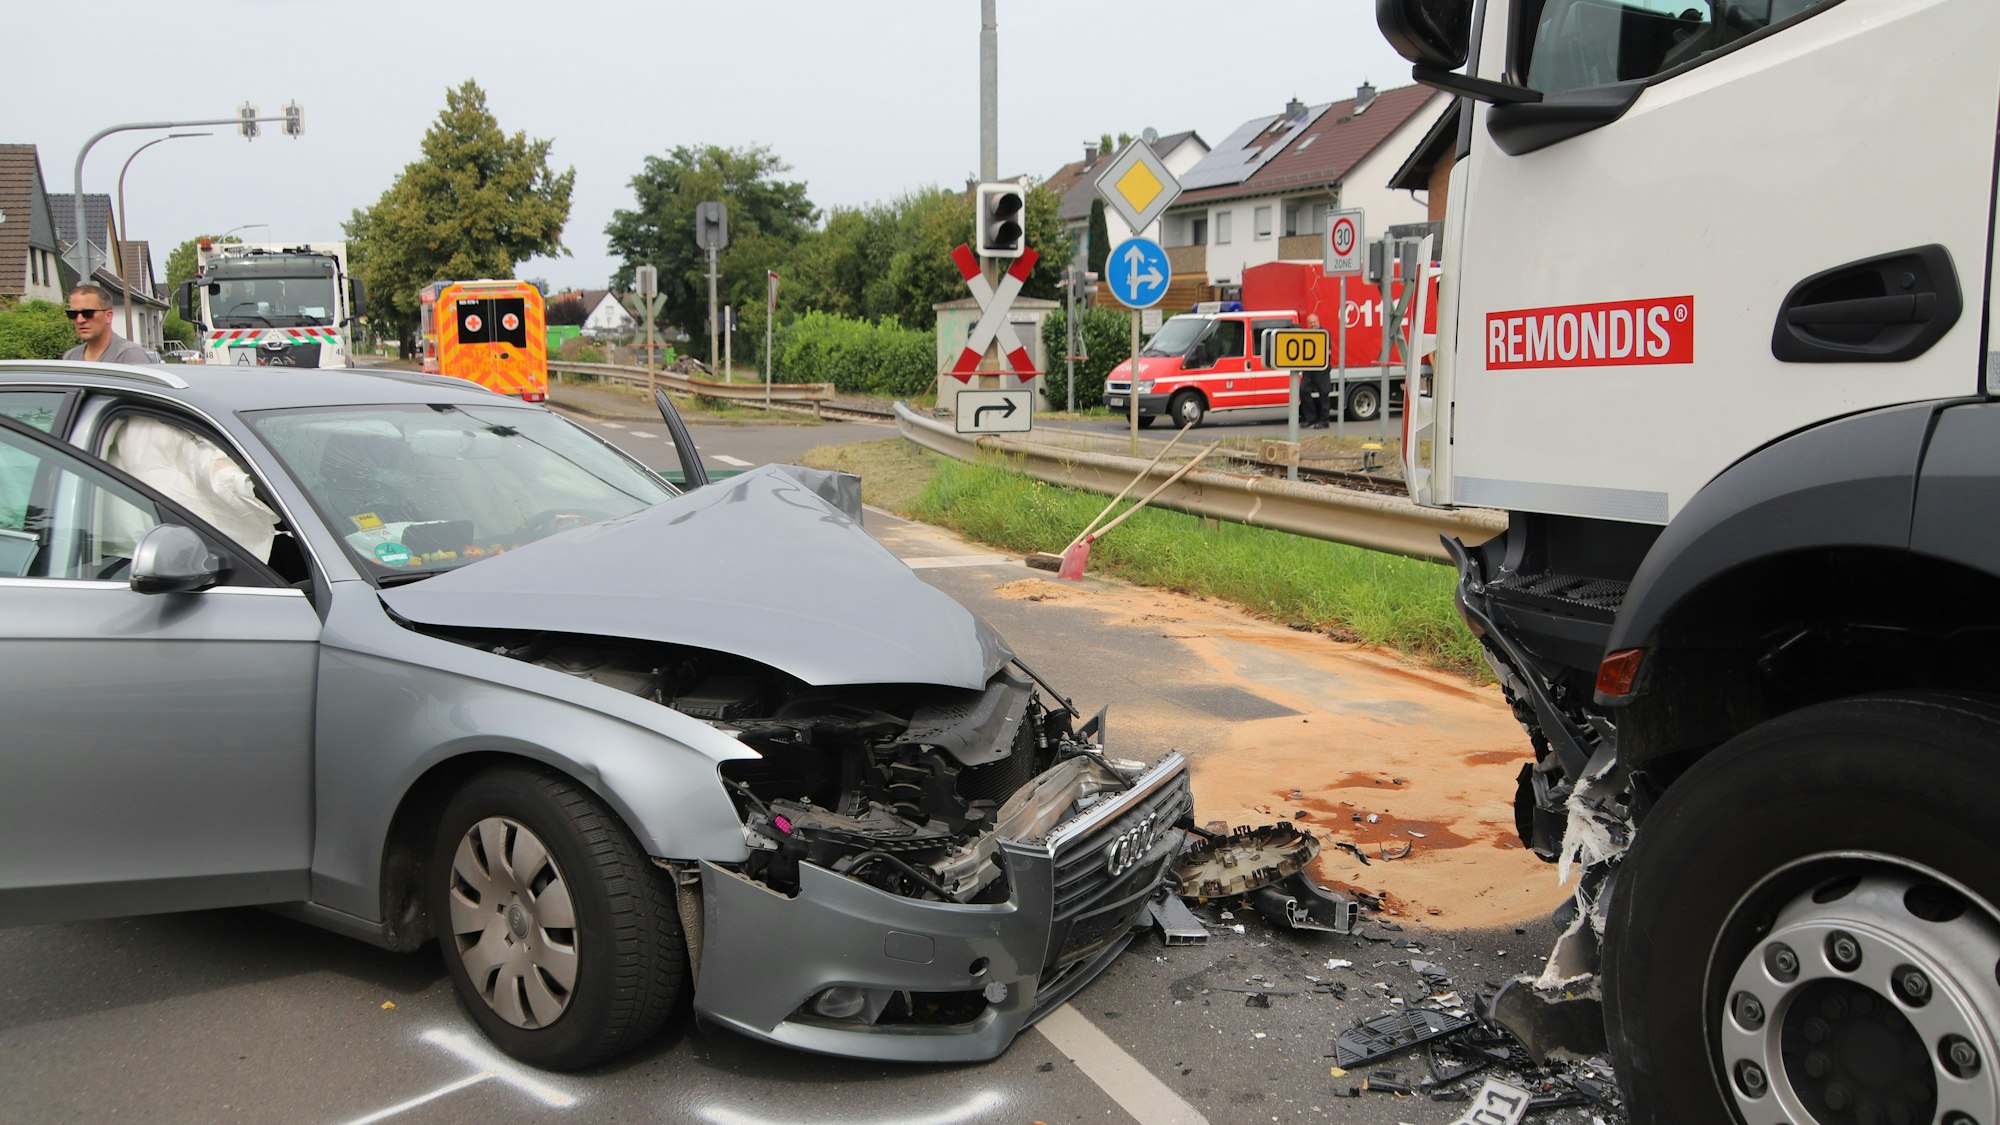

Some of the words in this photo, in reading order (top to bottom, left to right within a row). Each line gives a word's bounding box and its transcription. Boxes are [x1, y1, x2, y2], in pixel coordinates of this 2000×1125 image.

[1336, 228, 1351, 246] 30
[1334, 258, 1353, 269] ZONE
[1286, 338, 1316, 361] OD
[237, 352, 251, 366] A
